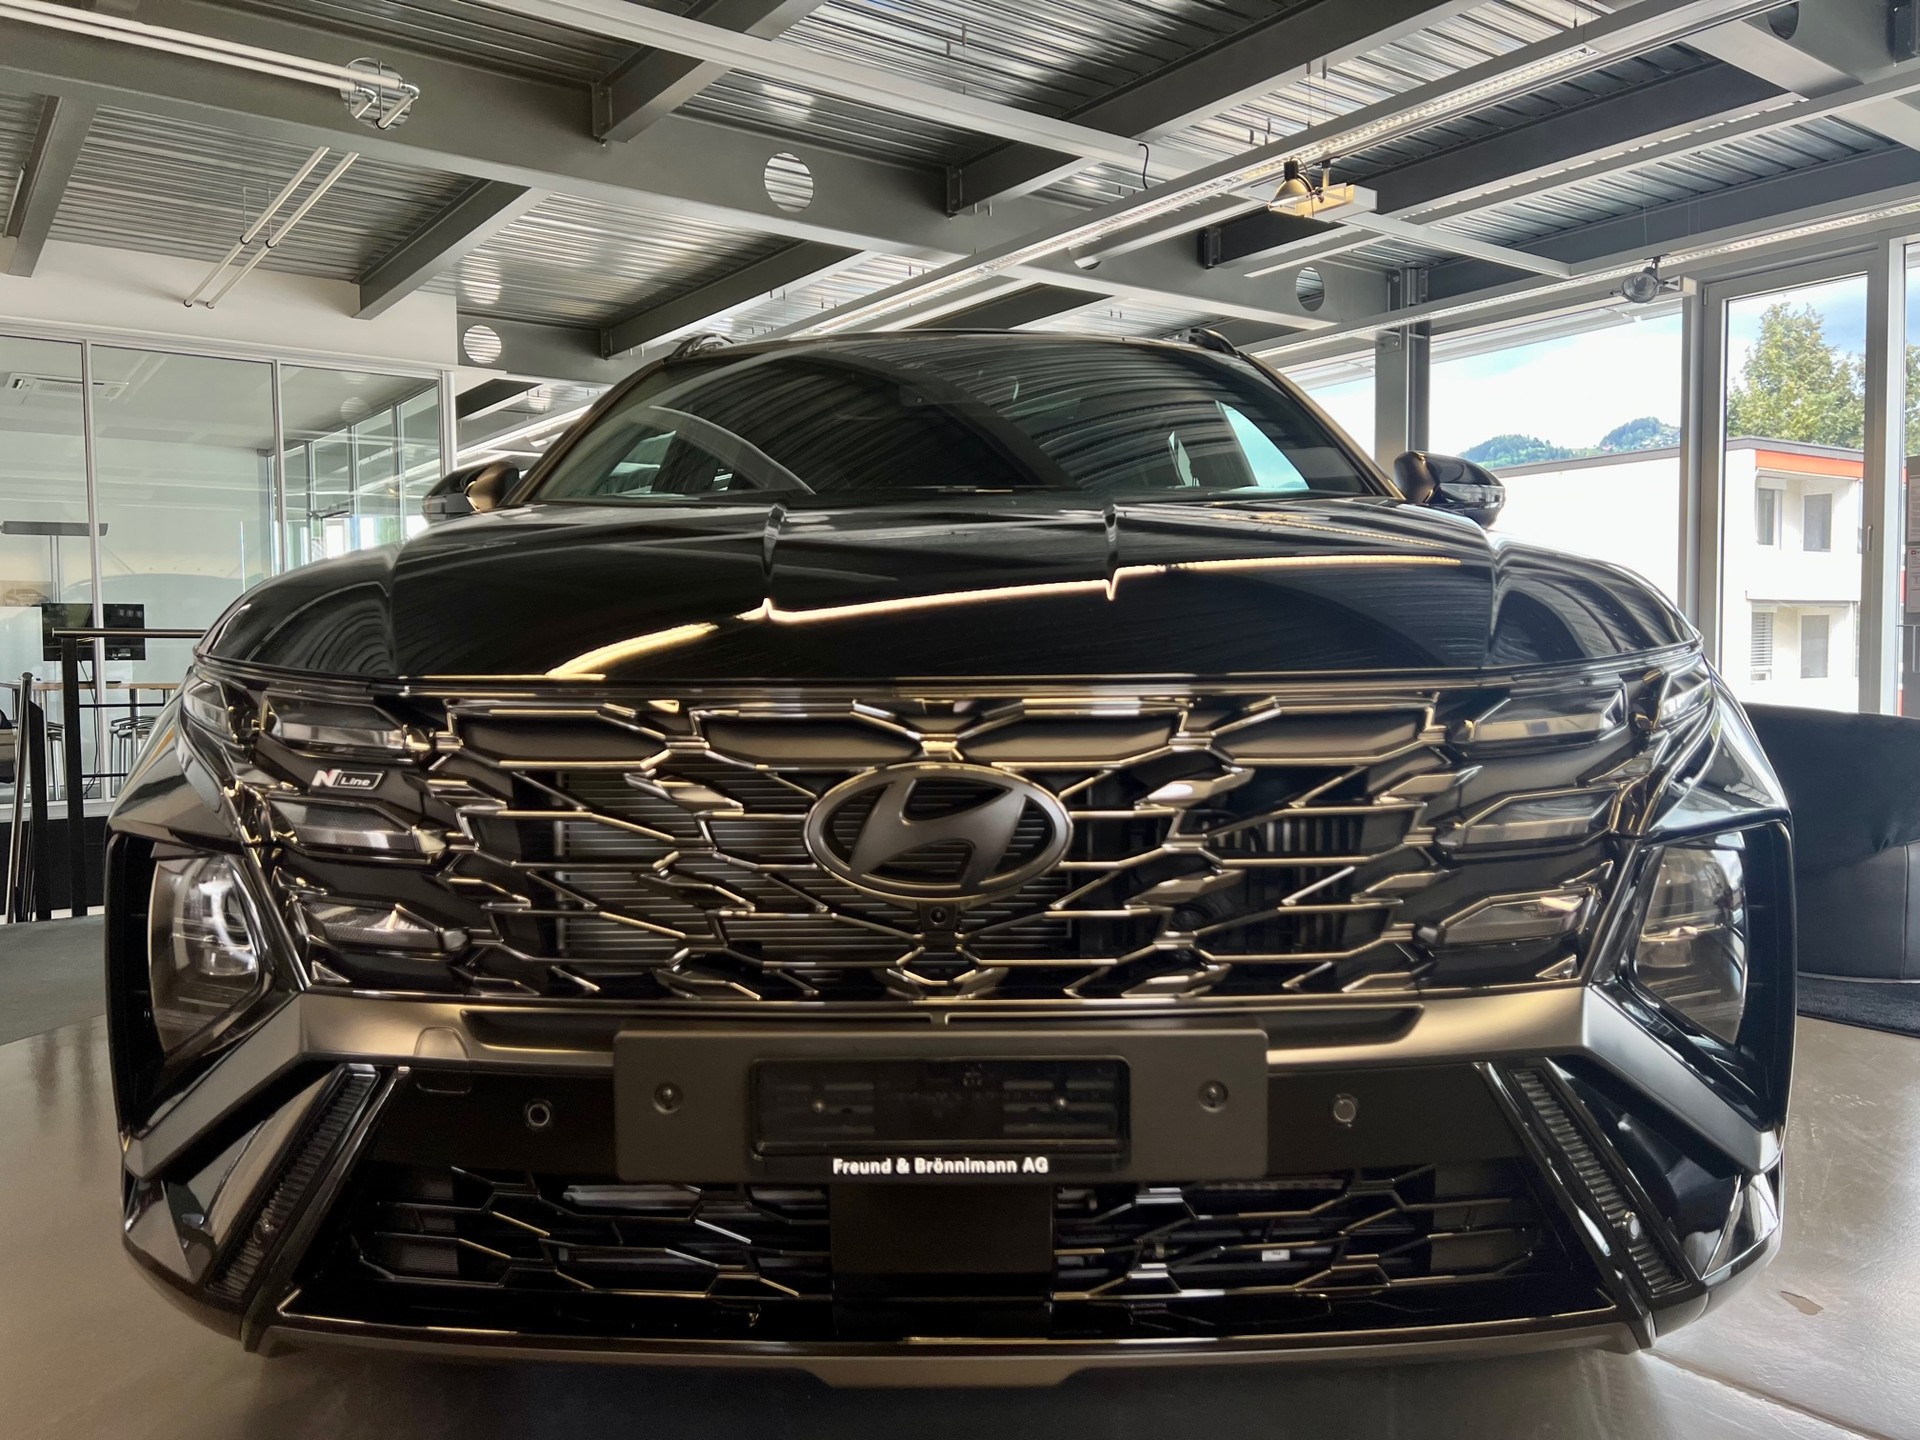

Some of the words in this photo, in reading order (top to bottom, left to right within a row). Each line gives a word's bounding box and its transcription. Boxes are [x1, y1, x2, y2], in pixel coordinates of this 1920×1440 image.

[311, 769, 341, 787] N
[340, 777, 371, 786] Line
[832, 1157, 892, 1175] Freund
[895, 1156, 910, 1175] &
[914, 1156, 1018, 1174] Brönnimann
[1022, 1156, 1049, 1174] AG
